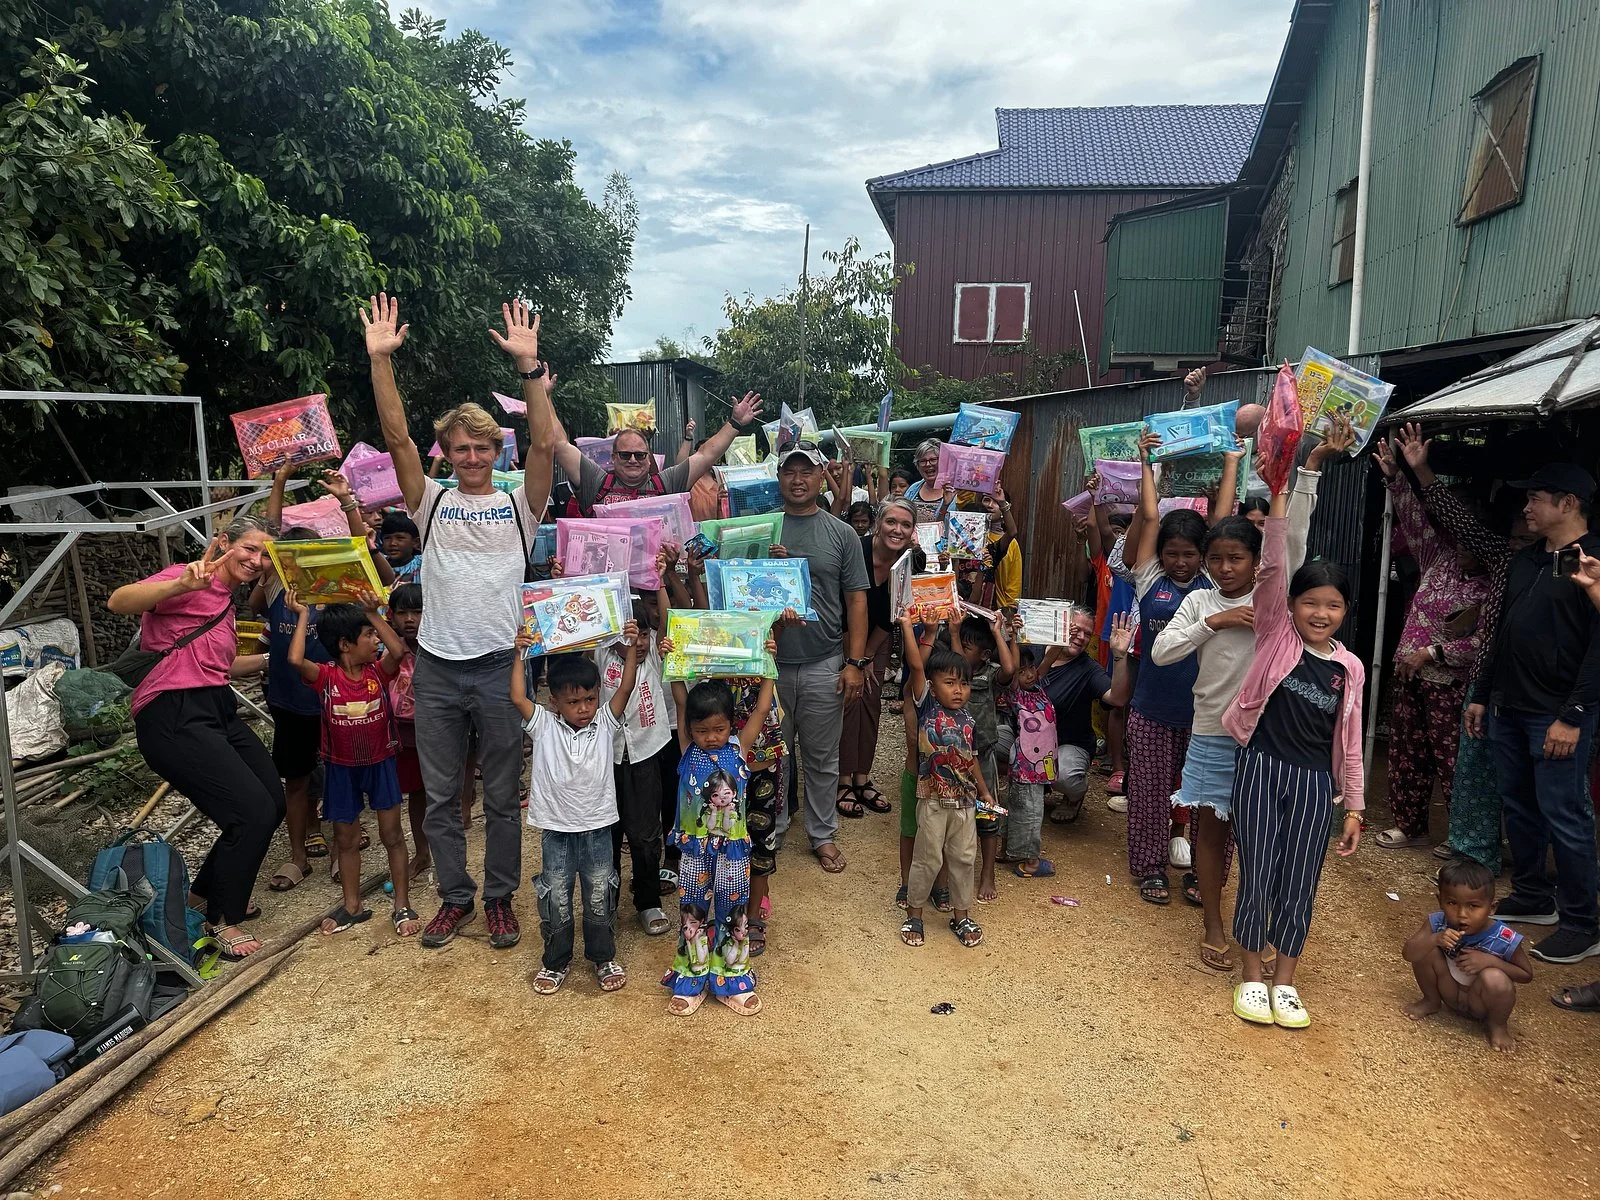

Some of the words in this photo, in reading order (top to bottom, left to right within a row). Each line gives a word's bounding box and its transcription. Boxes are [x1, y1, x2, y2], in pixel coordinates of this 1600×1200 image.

[247, 446, 264, 456] My
[266, 433, 306, 450] CLEAR
[306, 440, 333, 455] BAG
[1102, 450, 1131, 459] CLEAR
[1164, 470, 1181, 481] My
[440, 506, 500, 522] HOLLISTER
[318, 526, 344, 537] EAR
[640, 681, 653, 703] FREE
[331, 712, 384, 727] CHEVROLET
[646, 702, 657, 728] STYLE
[100, 1038, 116, 1052] JAMES
